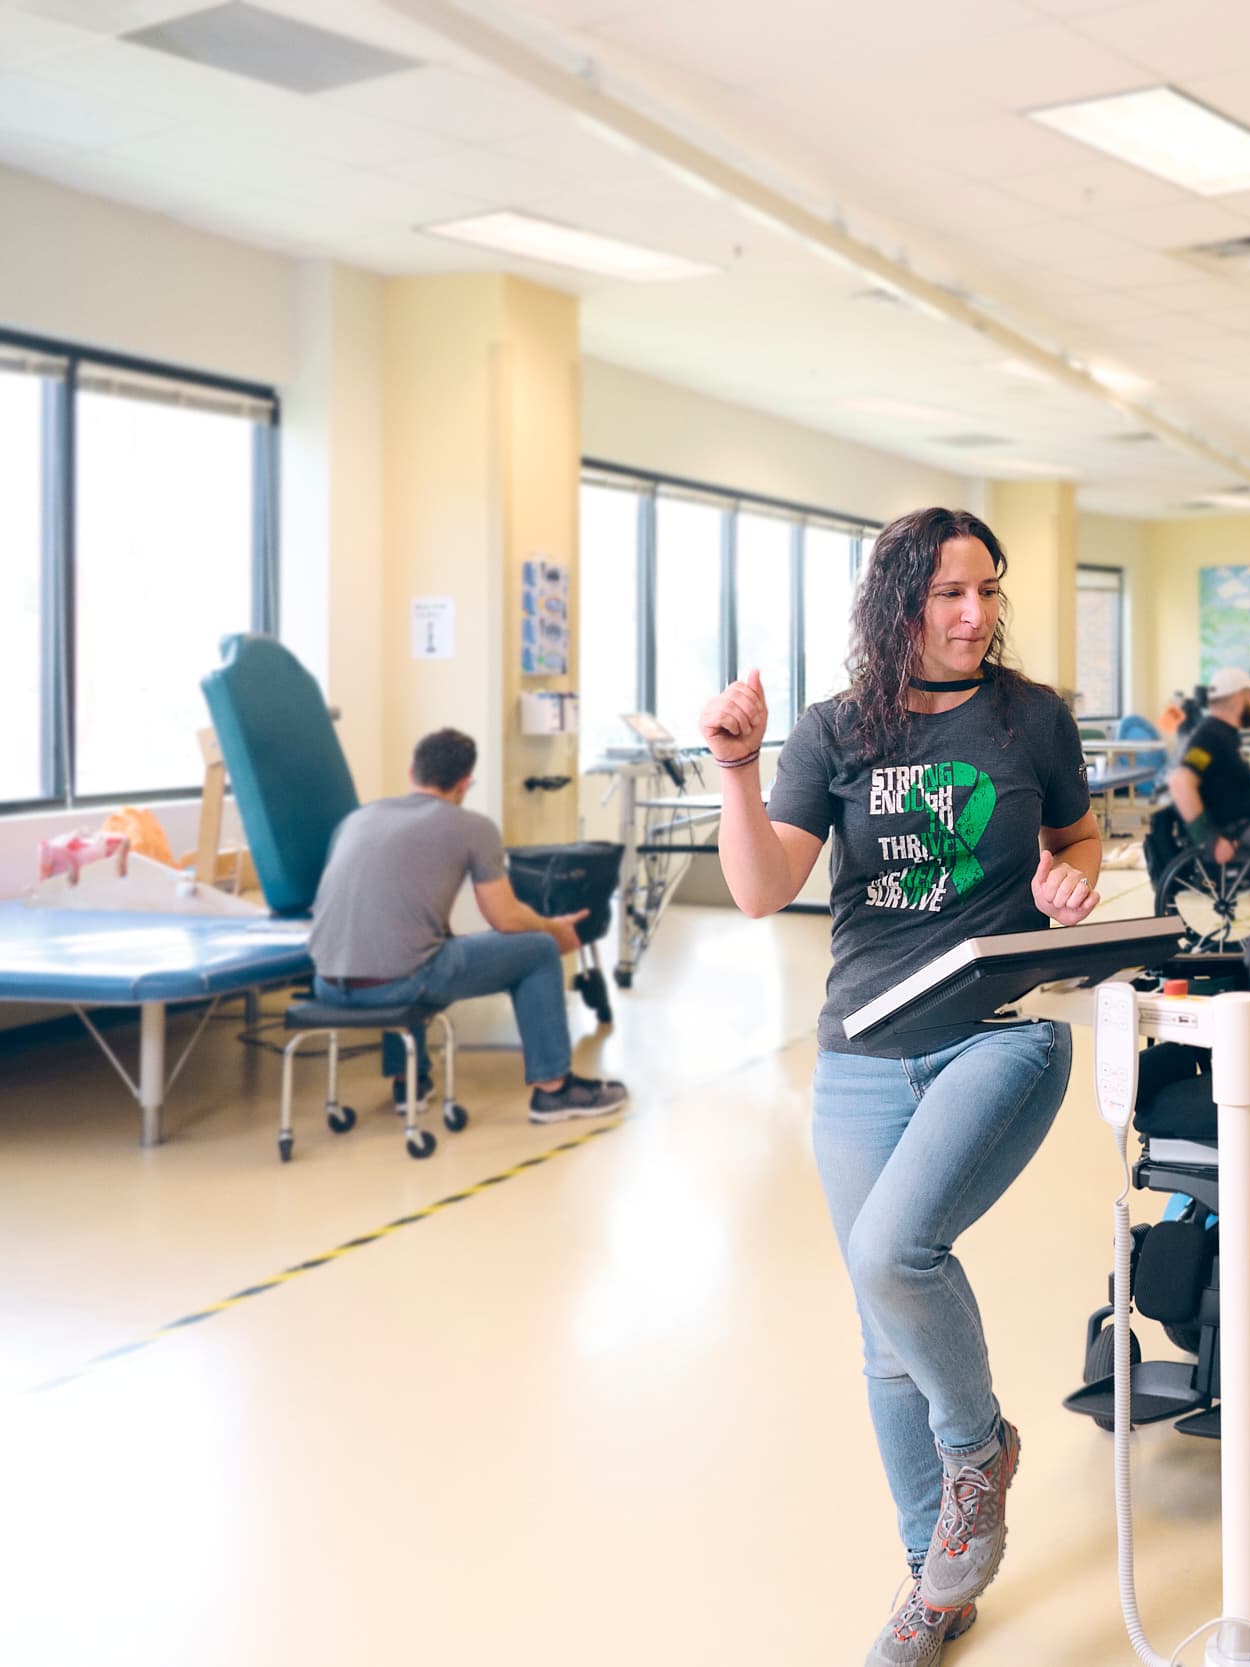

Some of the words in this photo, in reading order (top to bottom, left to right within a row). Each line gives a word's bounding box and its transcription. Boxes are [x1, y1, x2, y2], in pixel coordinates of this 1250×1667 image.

[872, 761, 953, 792] STRONG
[869, 786, 953, 815] ENOUGH
[878, 832, 957, 861] THRIVE
[865, 884, 947, 912] SURVIVE
